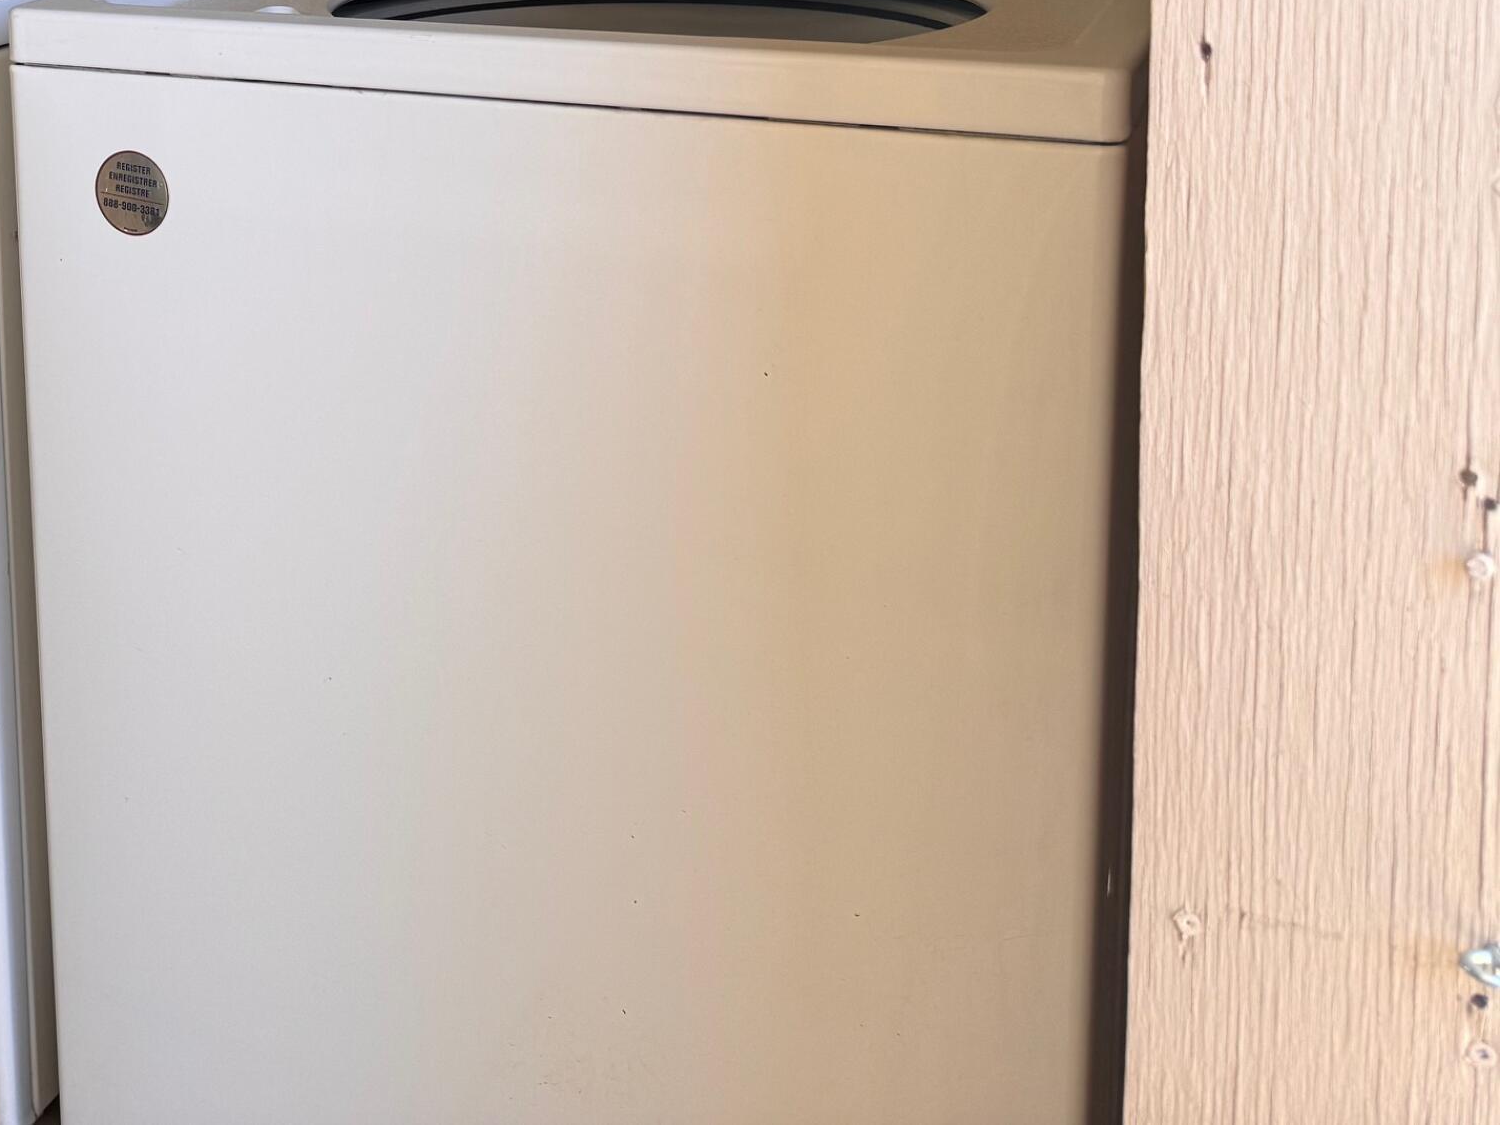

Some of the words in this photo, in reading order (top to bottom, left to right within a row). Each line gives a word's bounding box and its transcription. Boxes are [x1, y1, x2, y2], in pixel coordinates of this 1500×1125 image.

[116, 161, 151, 176] REGISTER
[108, 172, 157, 188] ENREGISTRER
[116, 184, 150, 198] REGISTRE
